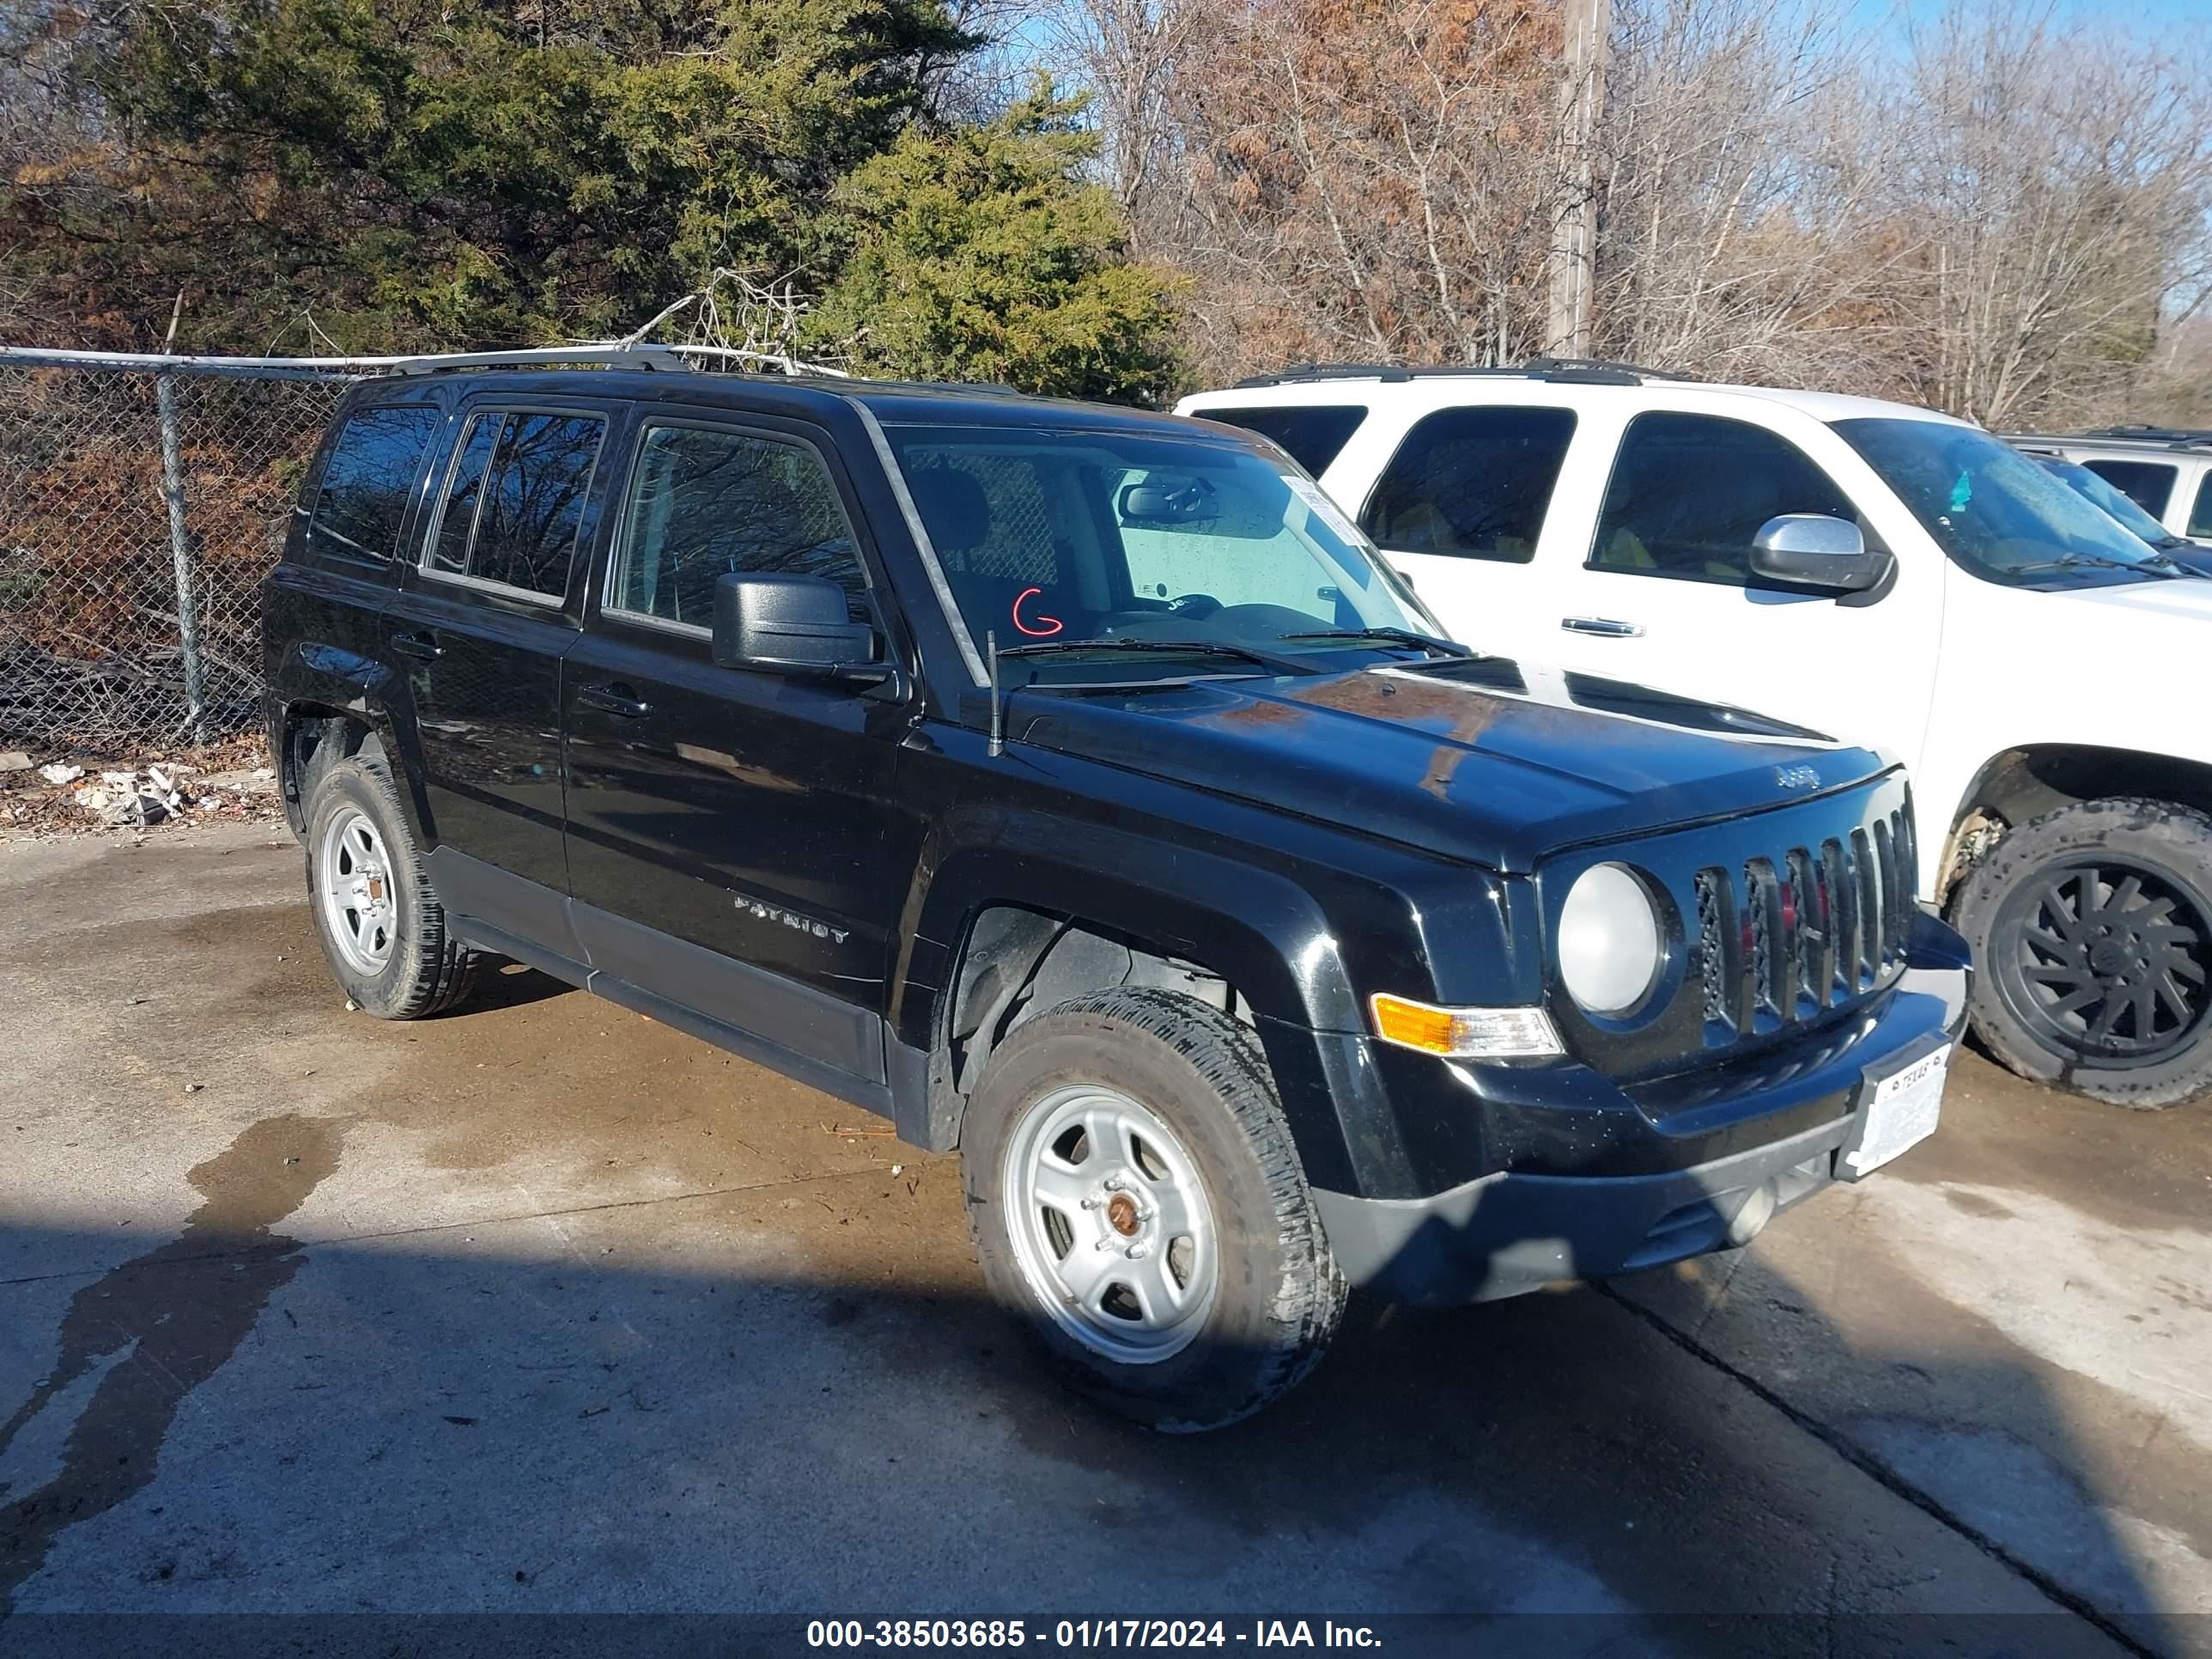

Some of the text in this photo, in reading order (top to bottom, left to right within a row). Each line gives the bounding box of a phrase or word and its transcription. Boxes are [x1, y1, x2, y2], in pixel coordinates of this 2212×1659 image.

[1012, 587, 1063, 636] G
[734, 896, 849, 945] PATRIOT
[1902, 1061, 1930, 1091] TEXAS
